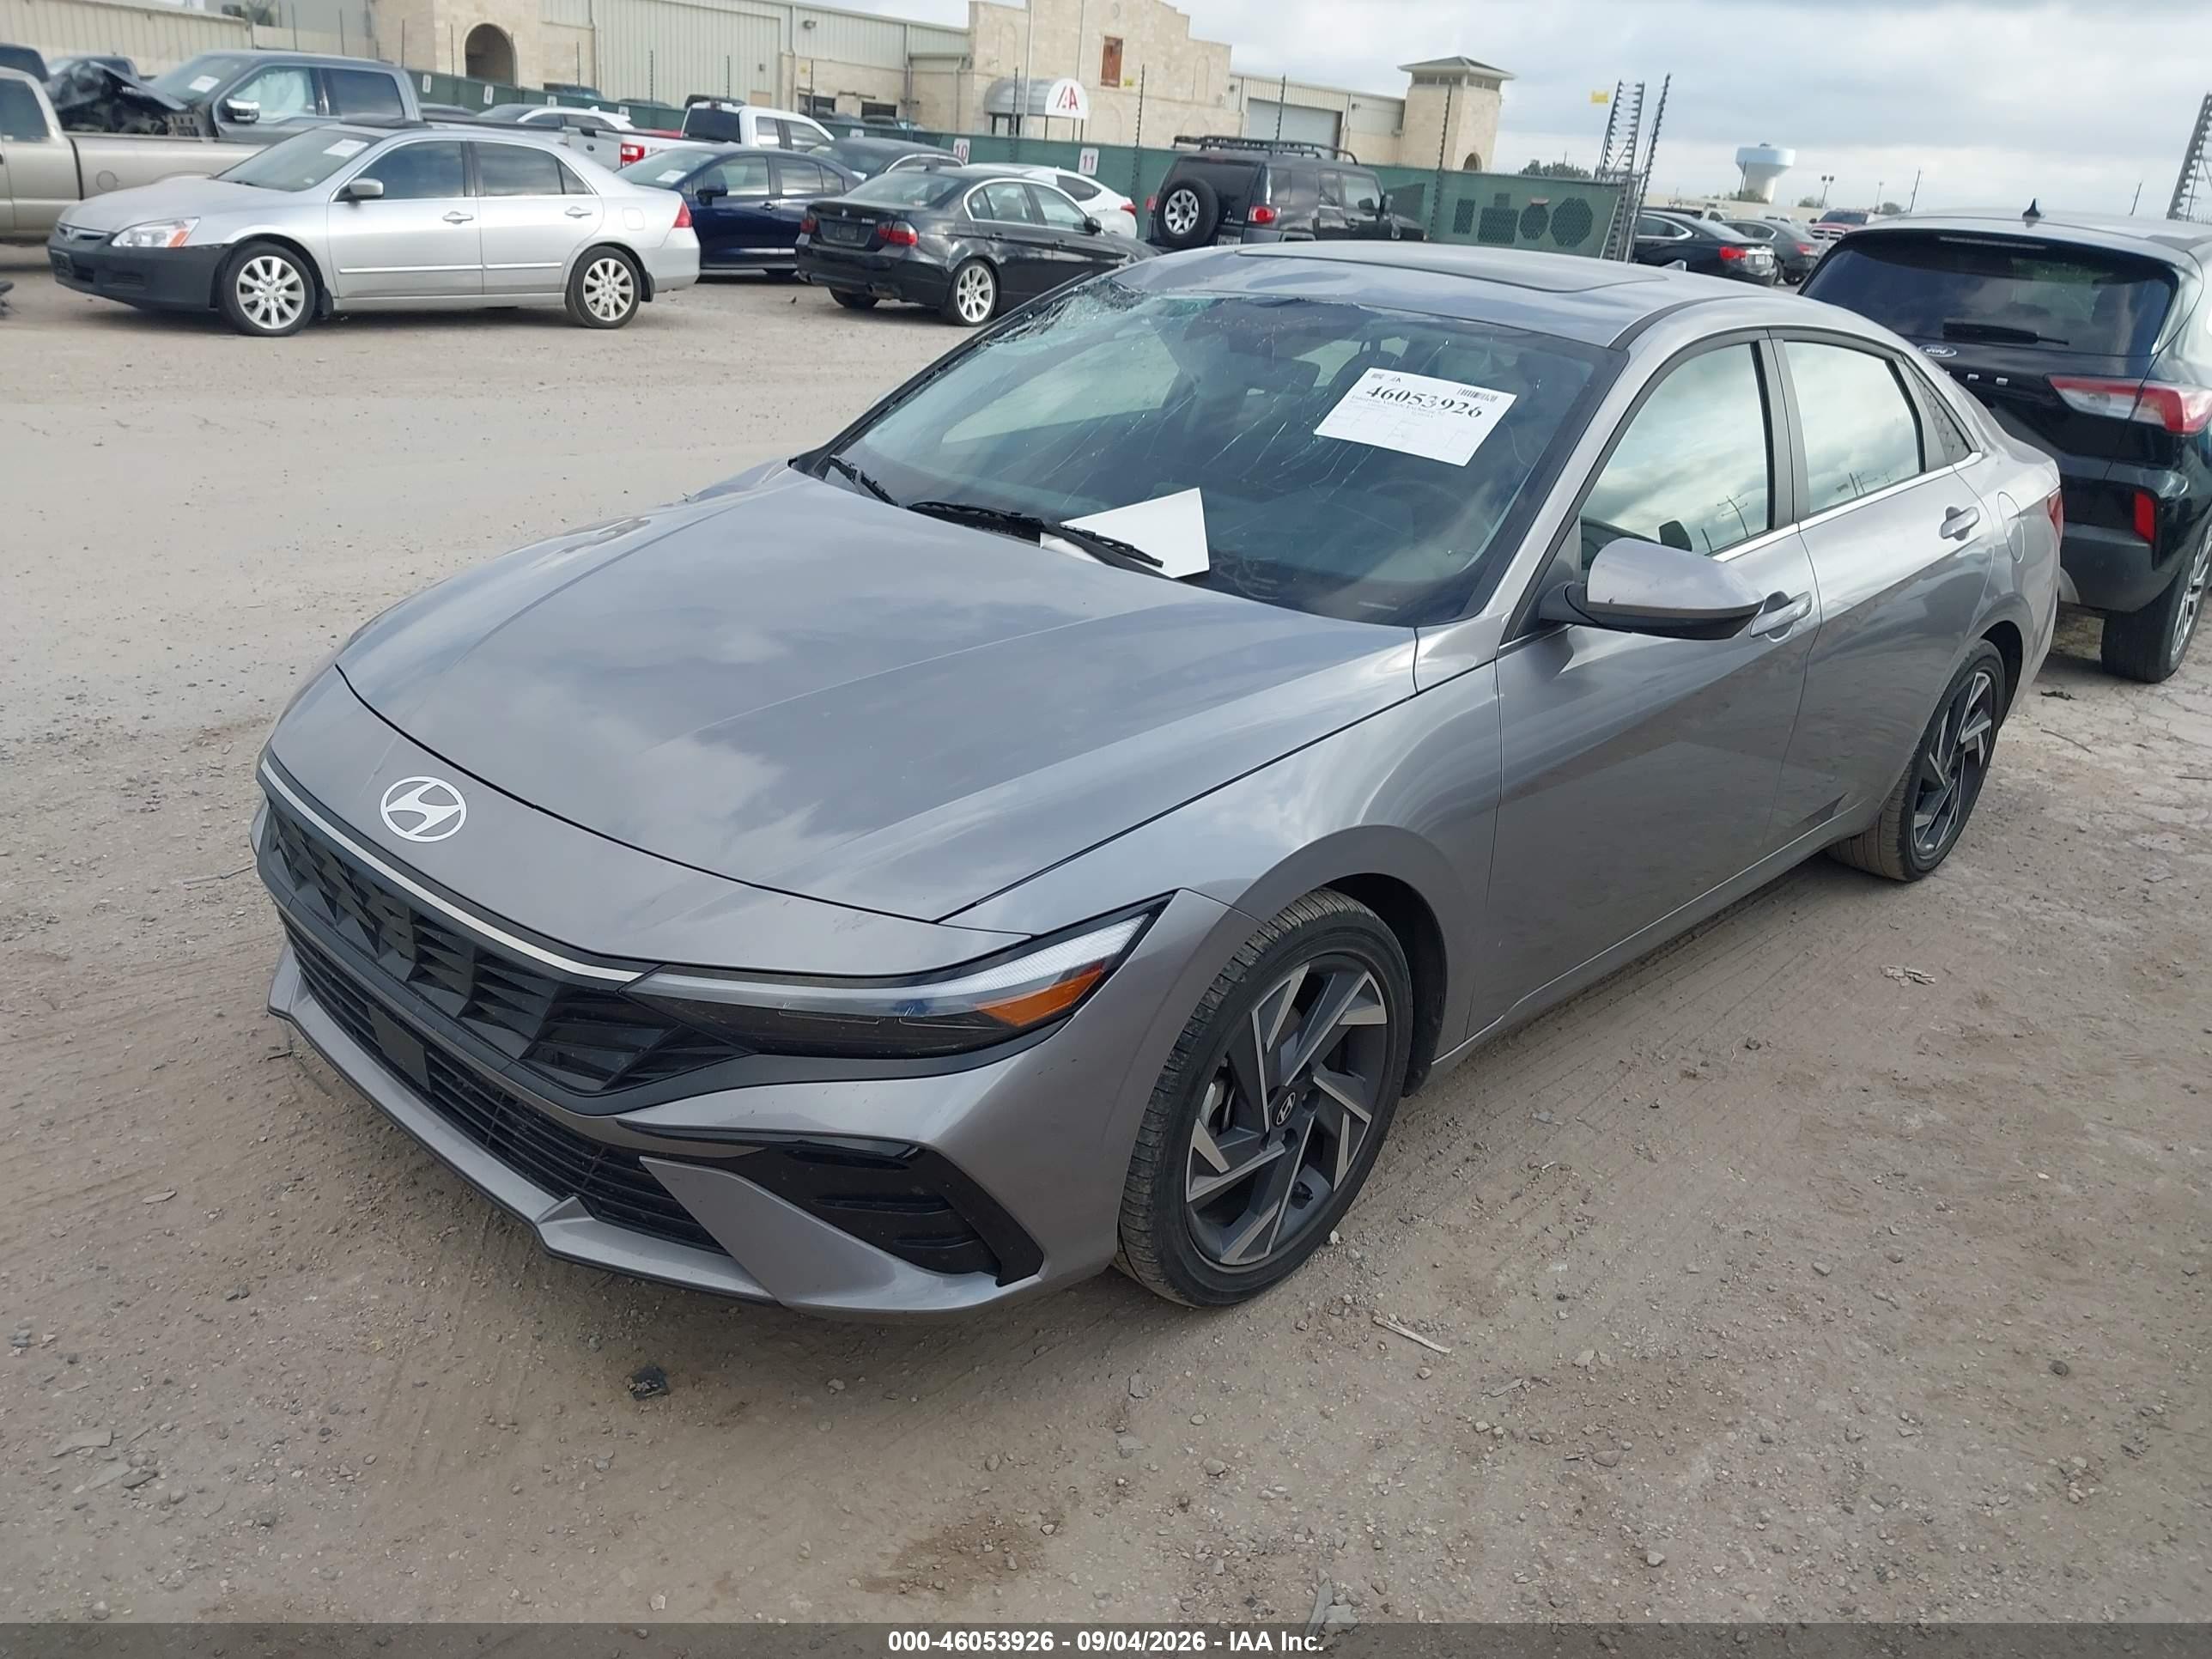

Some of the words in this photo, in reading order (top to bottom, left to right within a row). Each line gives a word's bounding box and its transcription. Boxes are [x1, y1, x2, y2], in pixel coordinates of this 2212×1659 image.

[954, 143, 969, 160] 10
[1083, 154, 1095, 171] 11
[1366, 385, 1483, 419] 46053926
